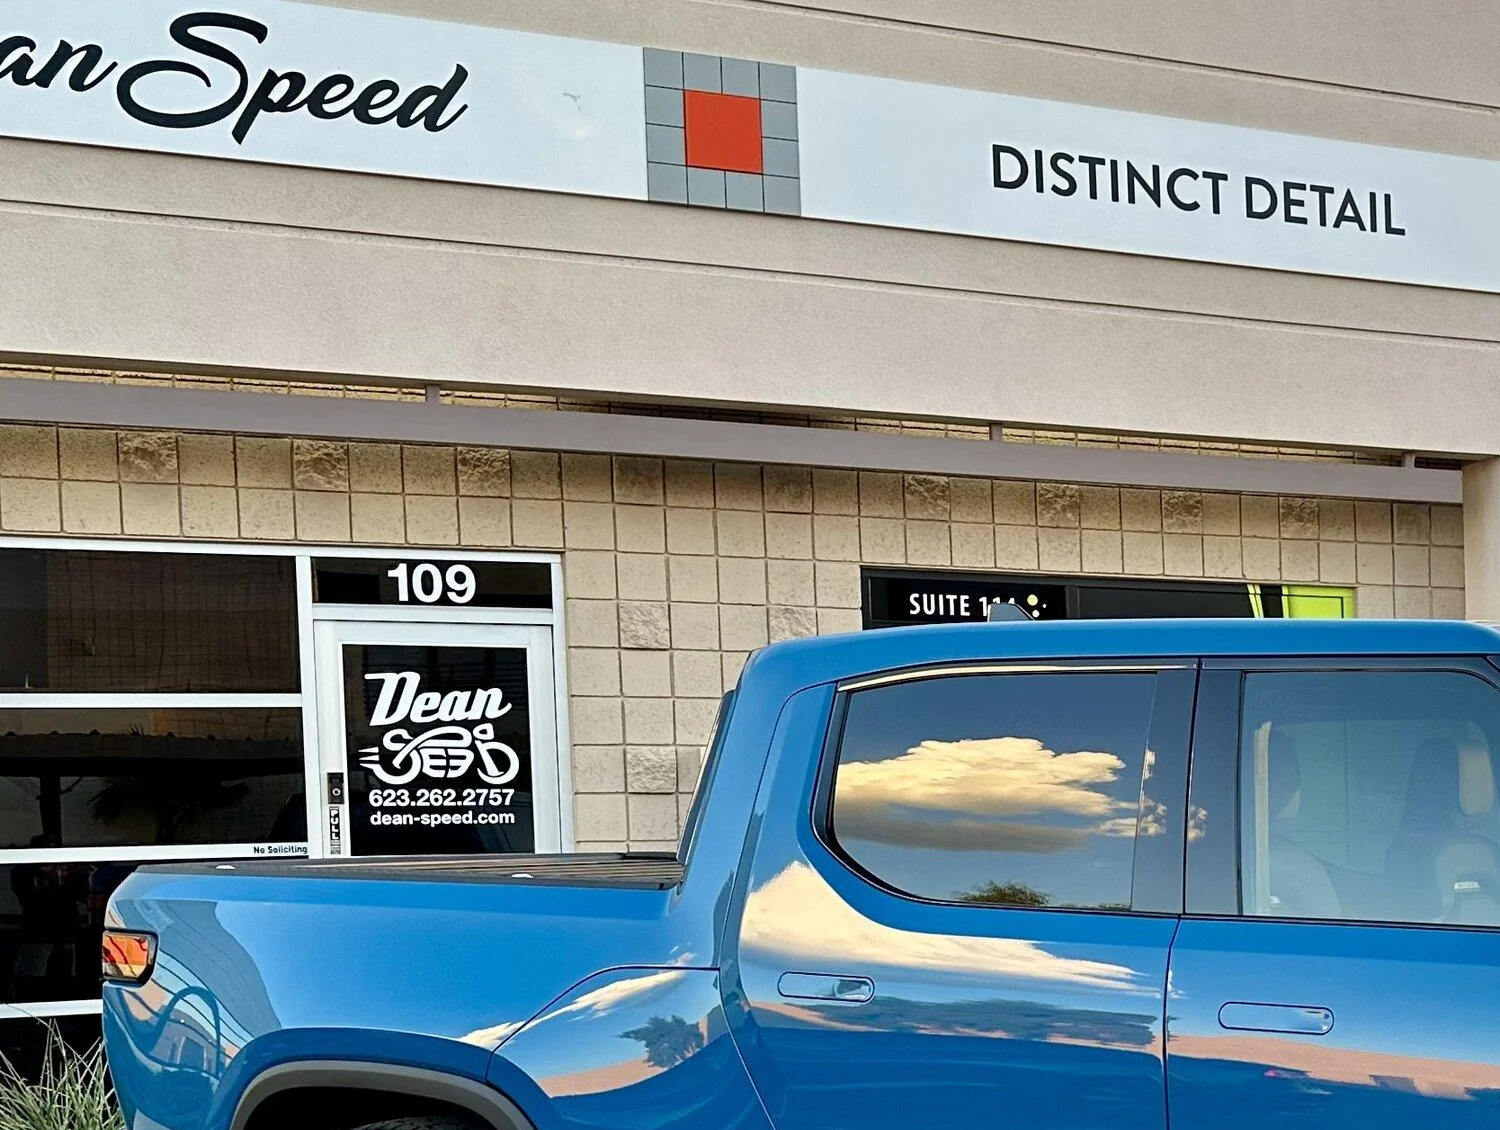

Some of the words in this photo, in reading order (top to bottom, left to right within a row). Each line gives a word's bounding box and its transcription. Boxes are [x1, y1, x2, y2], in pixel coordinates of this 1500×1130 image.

[116, 12, 469, 146] Speed
[991, 143, 1229, 216] DISTINCT
[1244, 175, 1407, 237] DETAIL
[386, 562, 477, 605] 109
[909, 592, 971, 617] SUITE
[364, 671, 513, 727] Dean
[368, 788, 516, 807] 623.262.2757
[369, 811, 516, 828] dean-speed.com
[253, 845, 266, 855] No
[267, 844, 308, 855] Soliciting
